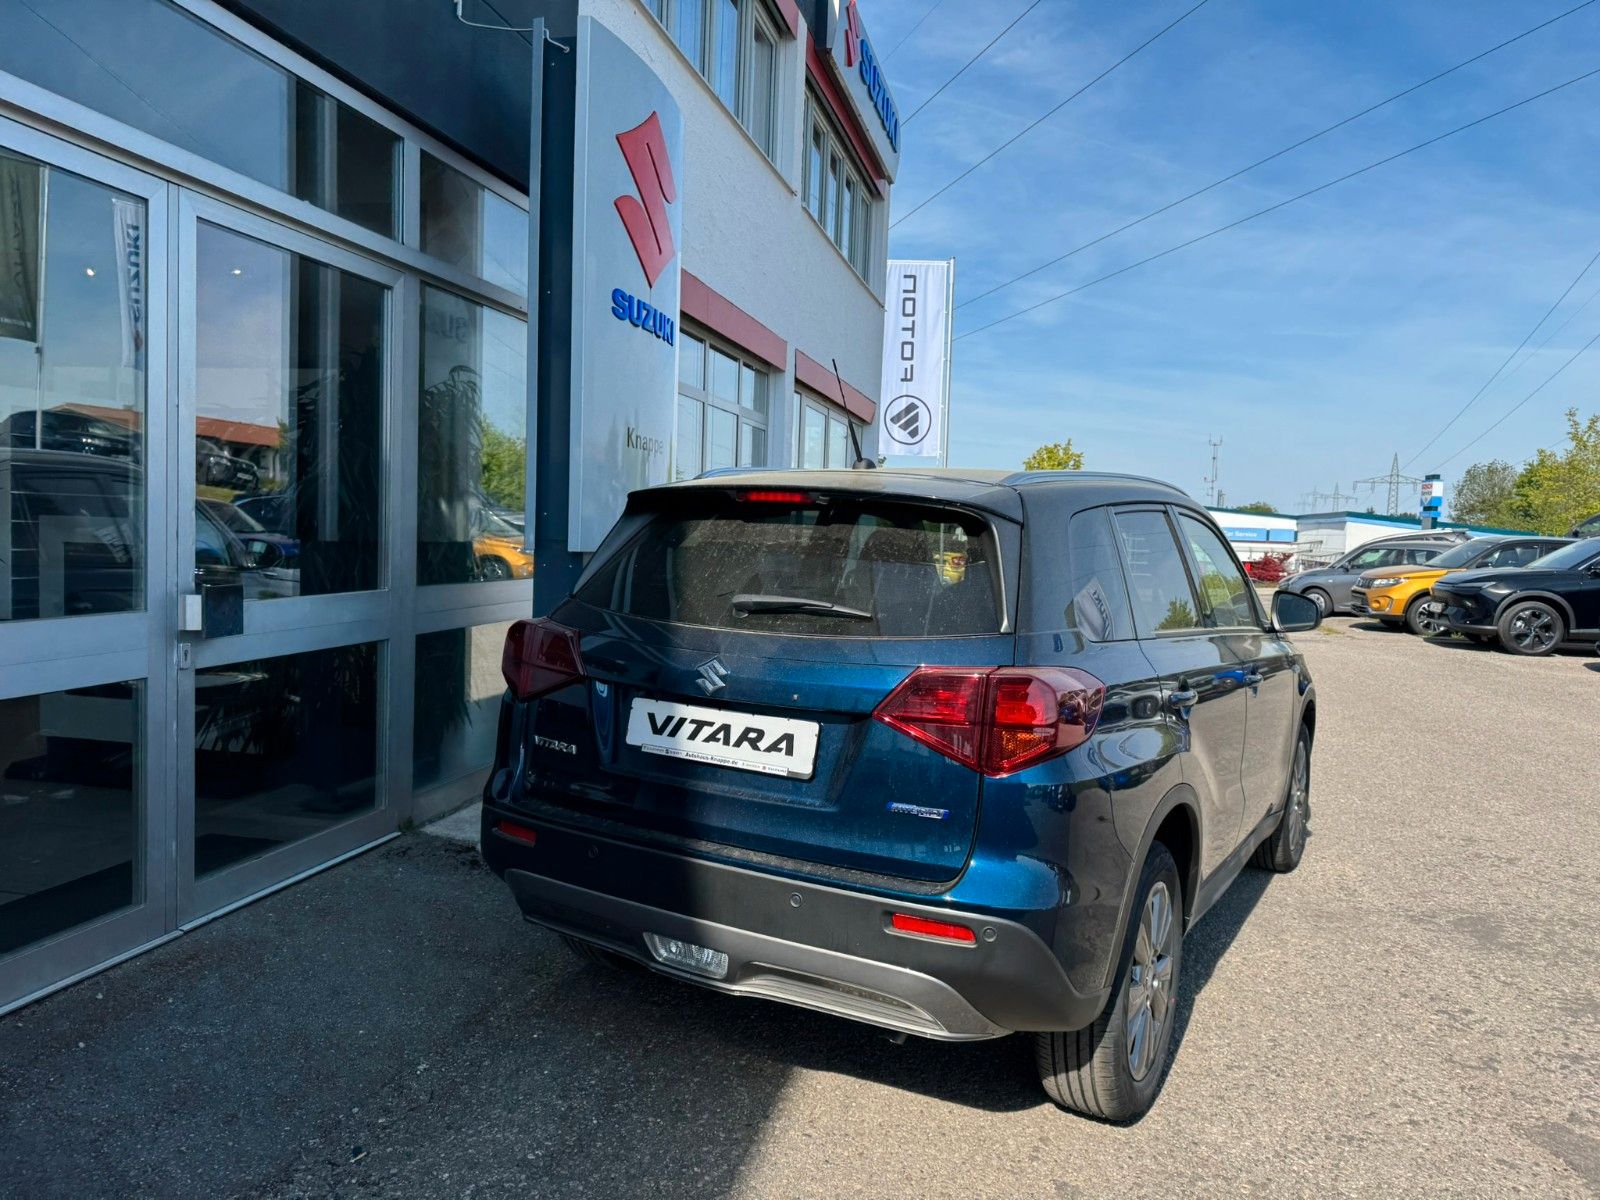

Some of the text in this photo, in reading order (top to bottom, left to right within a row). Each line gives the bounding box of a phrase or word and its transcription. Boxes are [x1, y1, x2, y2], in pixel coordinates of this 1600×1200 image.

[860, 38, 898, 154] SUZUKI
[611, 288, 674, 347] SUZUKI
[647, 712, 795, 757] VITARA
